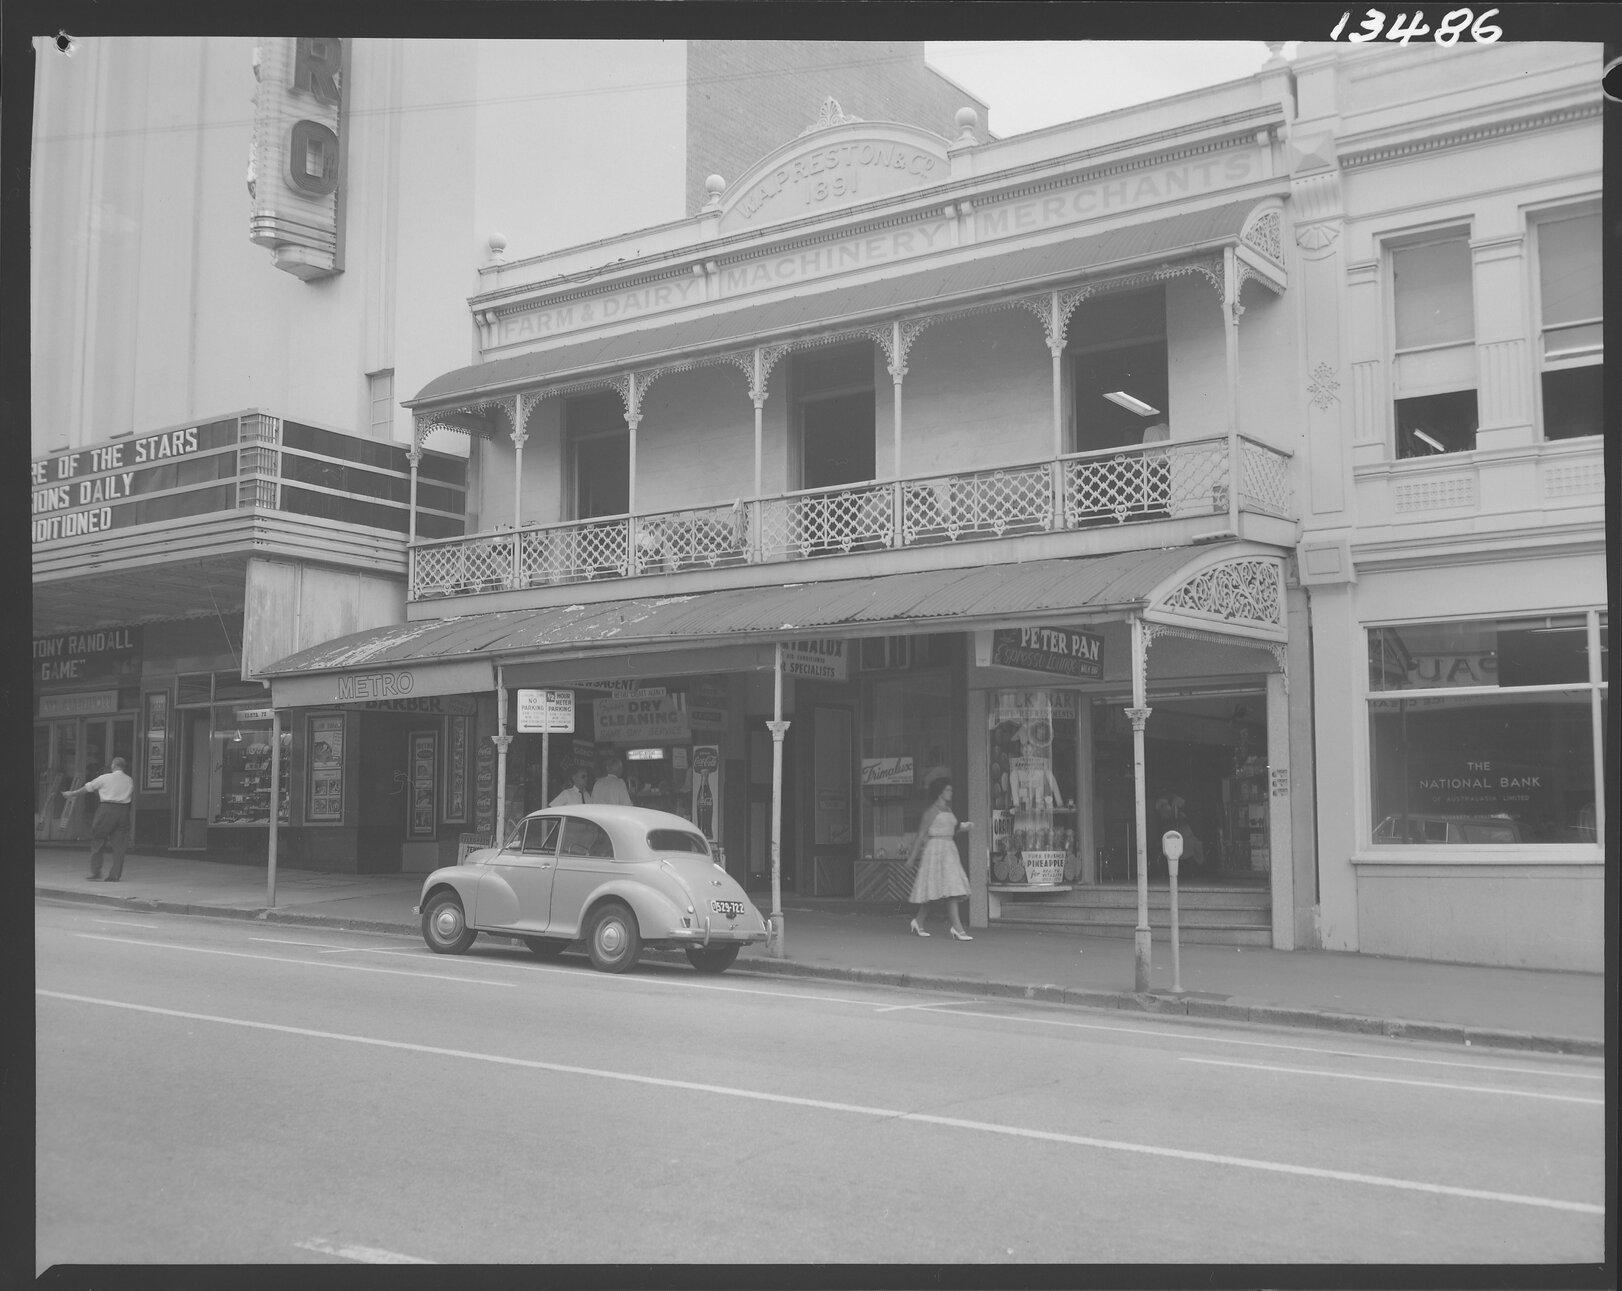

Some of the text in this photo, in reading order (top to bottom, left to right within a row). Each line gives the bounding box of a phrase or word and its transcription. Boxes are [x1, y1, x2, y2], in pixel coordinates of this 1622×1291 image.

[1329, 7, 1503, 48] 13486
[805, 170, 858, 205] 1891
[504, 152, 1252, 339] FARM & DAIRY MACHINERY MERCHANTS
[58, 454, 80, 480] OF
[90, 444, 125, 473] THE
[135, 428, 198, 463] STARS
[80, 472, 135, 505] DAILY
[68, 629, 134, 655] RANDALL
[1021, 627, 1069, 654] PETER
[1071, 635, 1100, 661] PAN
[790, 662, 835, 678] SPECIALISTS
[338, 671, 414, 699] METRO
[366, 697, 443, 712] BARBER
[628, 699, 662, 713] DRY
[599, 711, 678, 727] CLEANING
[863, 758, 912, 784] Trimalux
[1467, 761, 1491, 771] THE
[1419, 776, 1541, 789] NATIONAL BANK
[1027, 859, 1064, 867] PINEAPPLE
